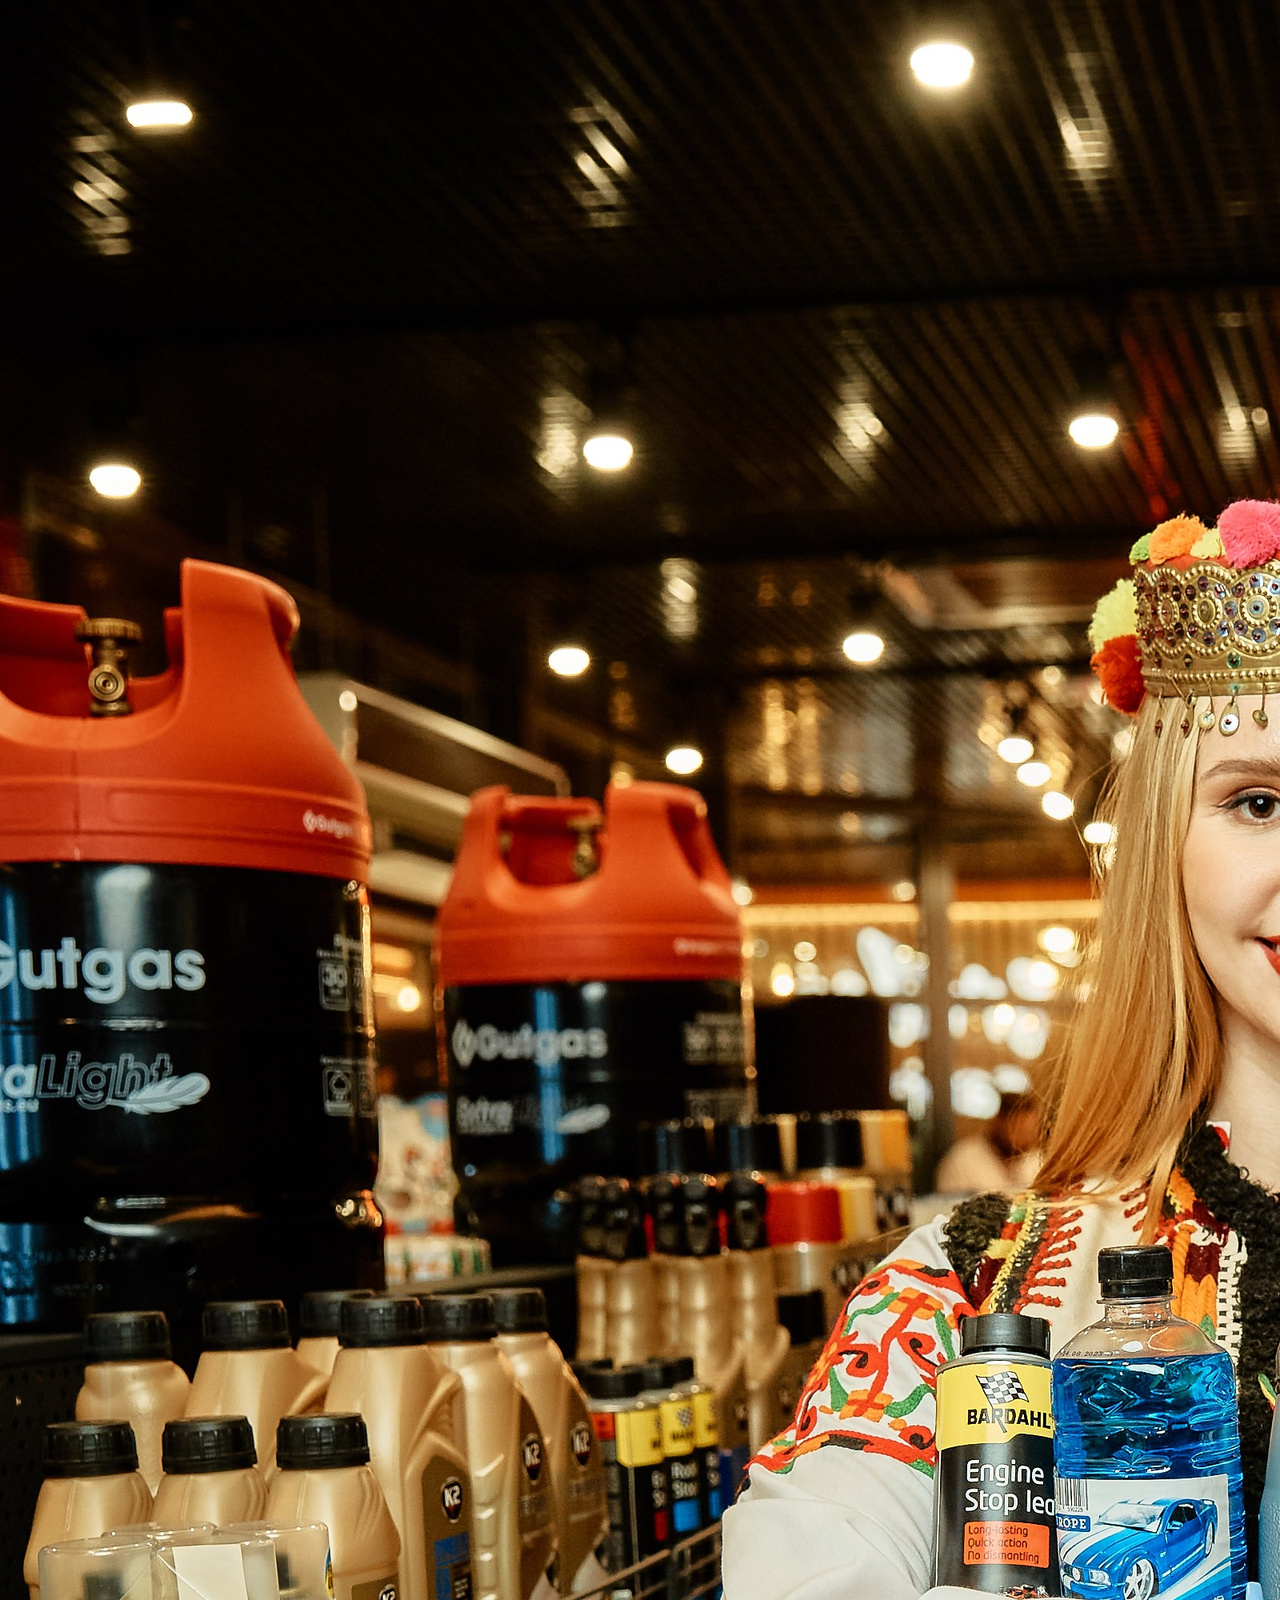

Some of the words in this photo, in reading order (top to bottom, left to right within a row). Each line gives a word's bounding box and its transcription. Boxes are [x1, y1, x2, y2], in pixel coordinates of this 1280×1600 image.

[0, 1051, 173, 1110] aLight
[967, 1407, 1051, 1430] BARDAHL
[966, 1459, 1044, 1486] Engine
[444, 1484, 462, 1507] K2
[965, 1488, 1019, 1515] Stop
[1026, 1489, 1056, 1516] lea
[968, 1524, 1029, 1538] Long-lasting
[1056, 1516, 1087, 1530] ROPE
[968, 1538, 994, 1549] Quick
[997, 1538, 1028, 1549] action
[967, 1551, 981, 1561] No
[983, 1552, 1039, 1565] dismantling
